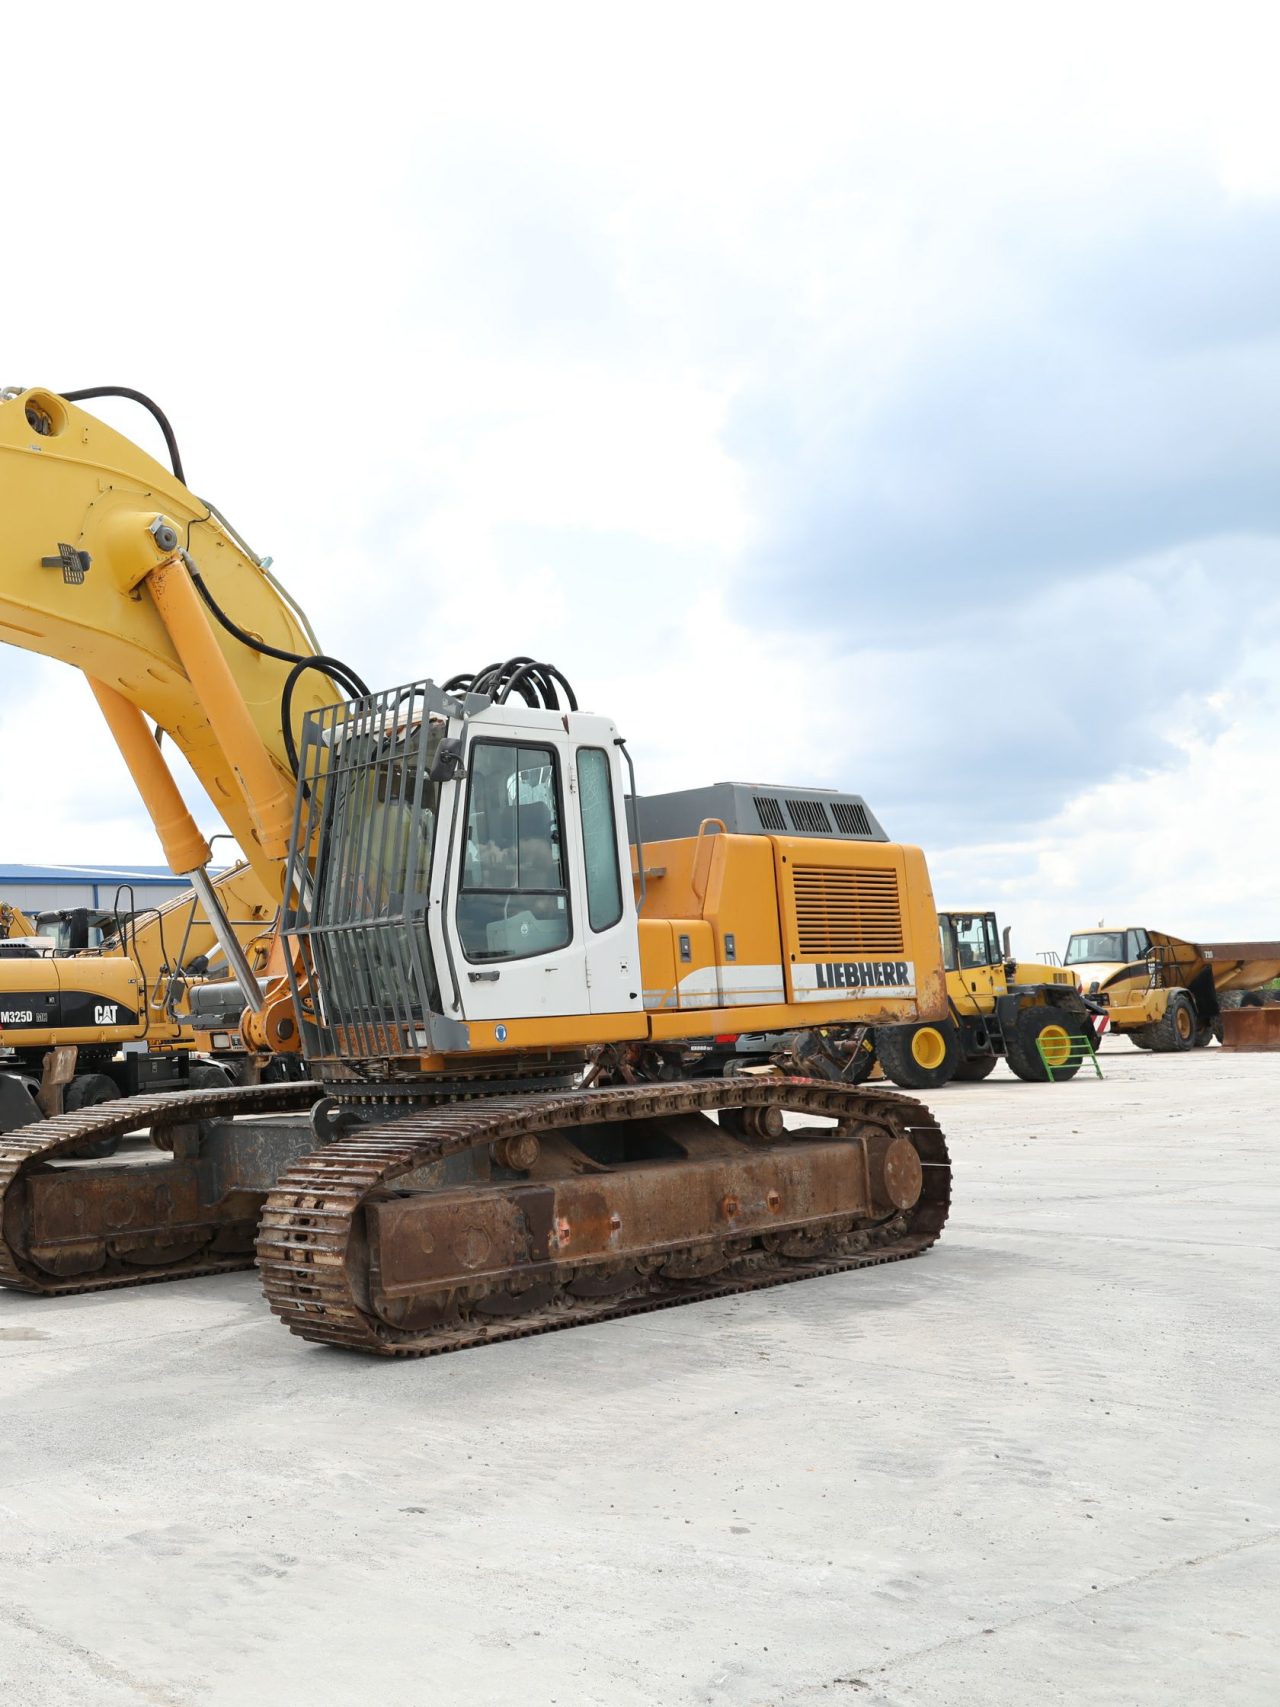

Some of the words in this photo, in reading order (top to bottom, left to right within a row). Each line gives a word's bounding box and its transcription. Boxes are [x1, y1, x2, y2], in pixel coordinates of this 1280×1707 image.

[815, 961, 910, 988] LIEBHERR
[0, 1011, 33, 1023] M325D
[94, 1005, 118, 1024] CAT
